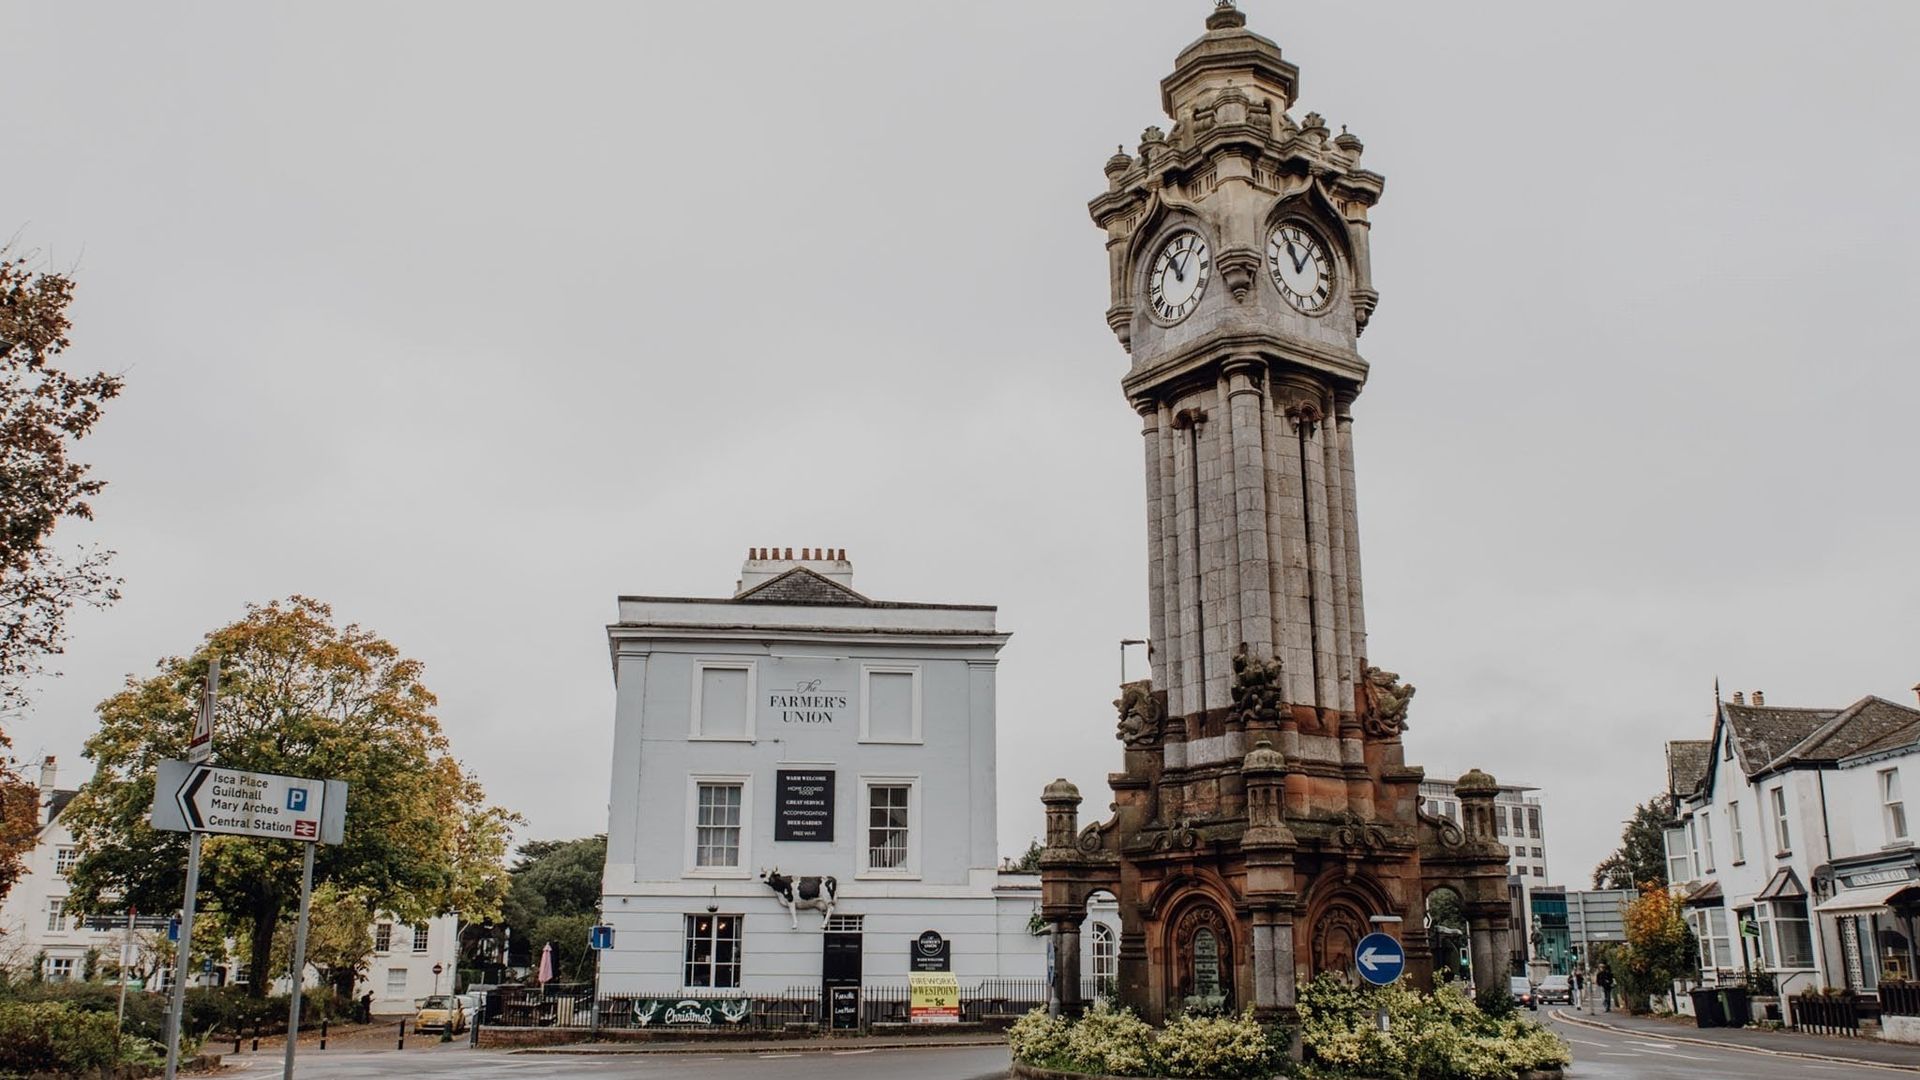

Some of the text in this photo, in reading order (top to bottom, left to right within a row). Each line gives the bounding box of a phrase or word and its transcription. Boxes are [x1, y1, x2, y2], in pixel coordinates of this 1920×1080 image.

[770, 695, 847, 708] FARMER'S
[783, 711, 833, 723] UNION
[214, 772, 269, 789] Isca Place
[212, 785, 262, 801] Guildhall
[211, 799, 279, 815] Mary Arches
[209, 815, 292, 833] Central Station
[665, 1007, 712, 1025] Christmas
